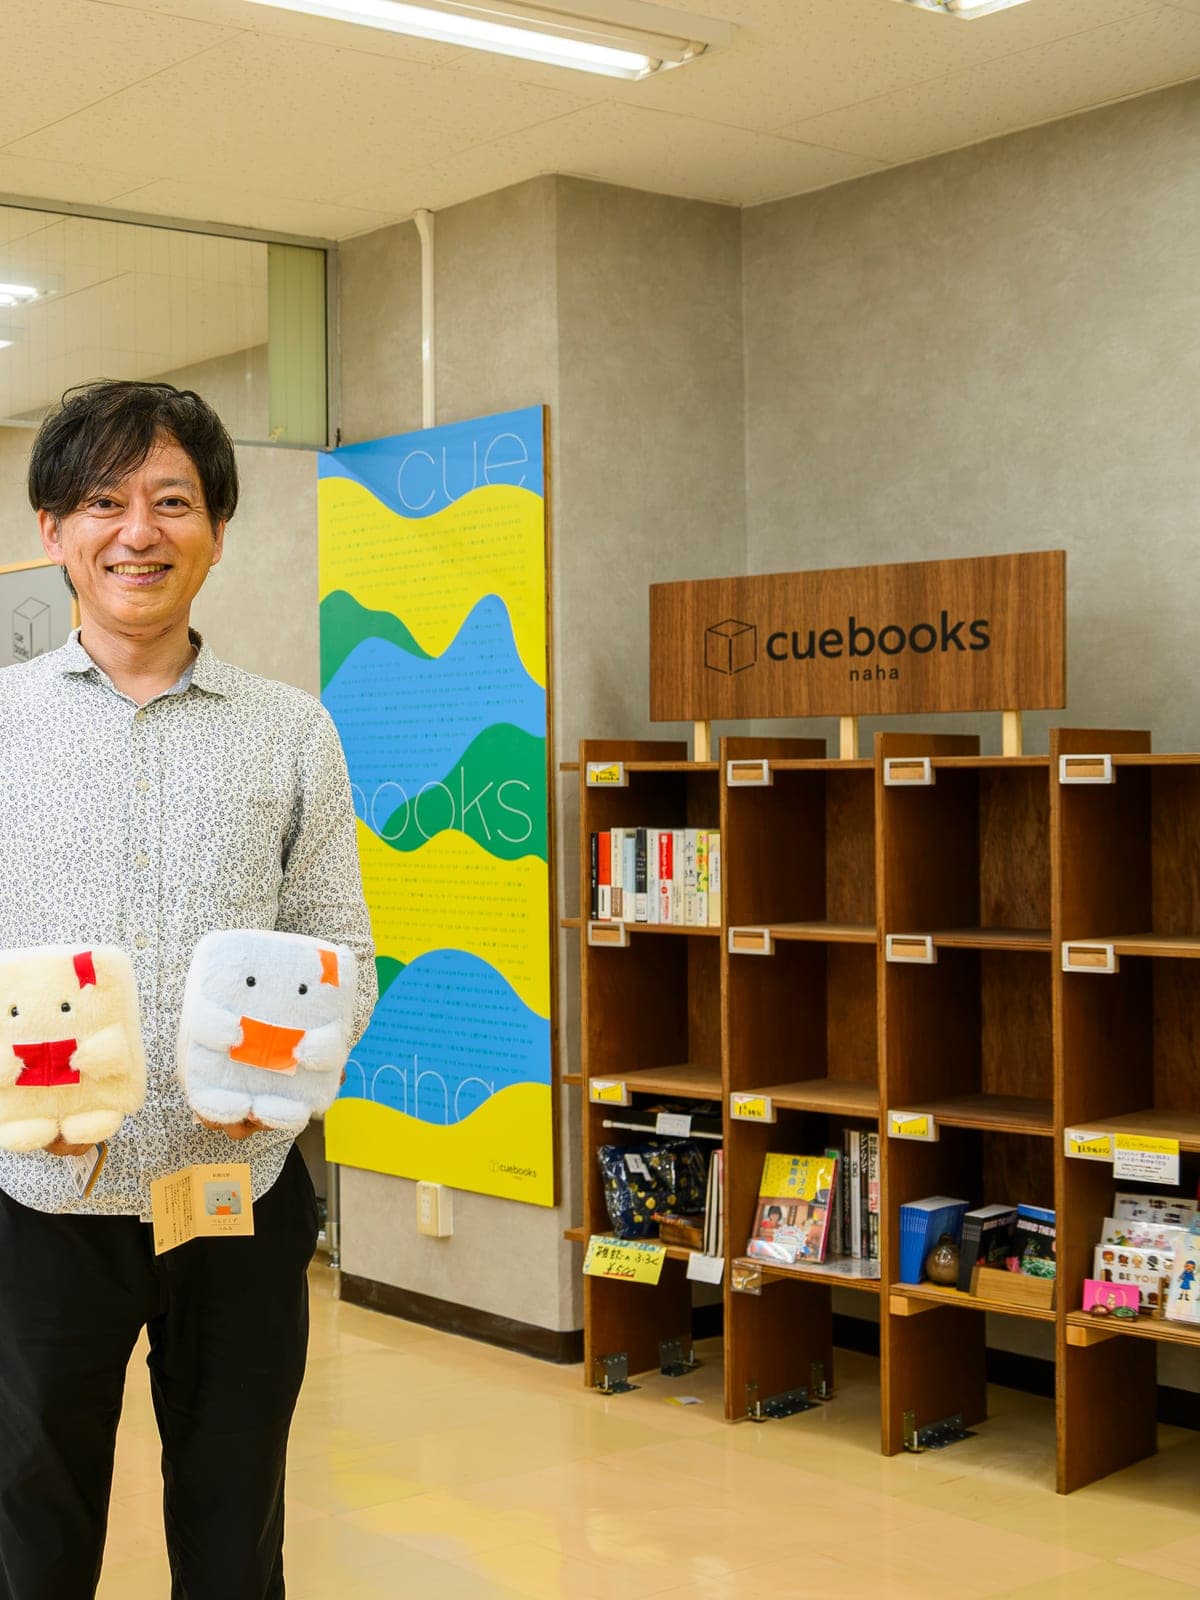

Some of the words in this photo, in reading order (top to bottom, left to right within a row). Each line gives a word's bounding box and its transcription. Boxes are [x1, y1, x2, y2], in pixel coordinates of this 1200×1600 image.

[397, 432, 529, 510] cue
[766, 610, 991, 661] cuebooks
[849, 663, 900, 682] naha
